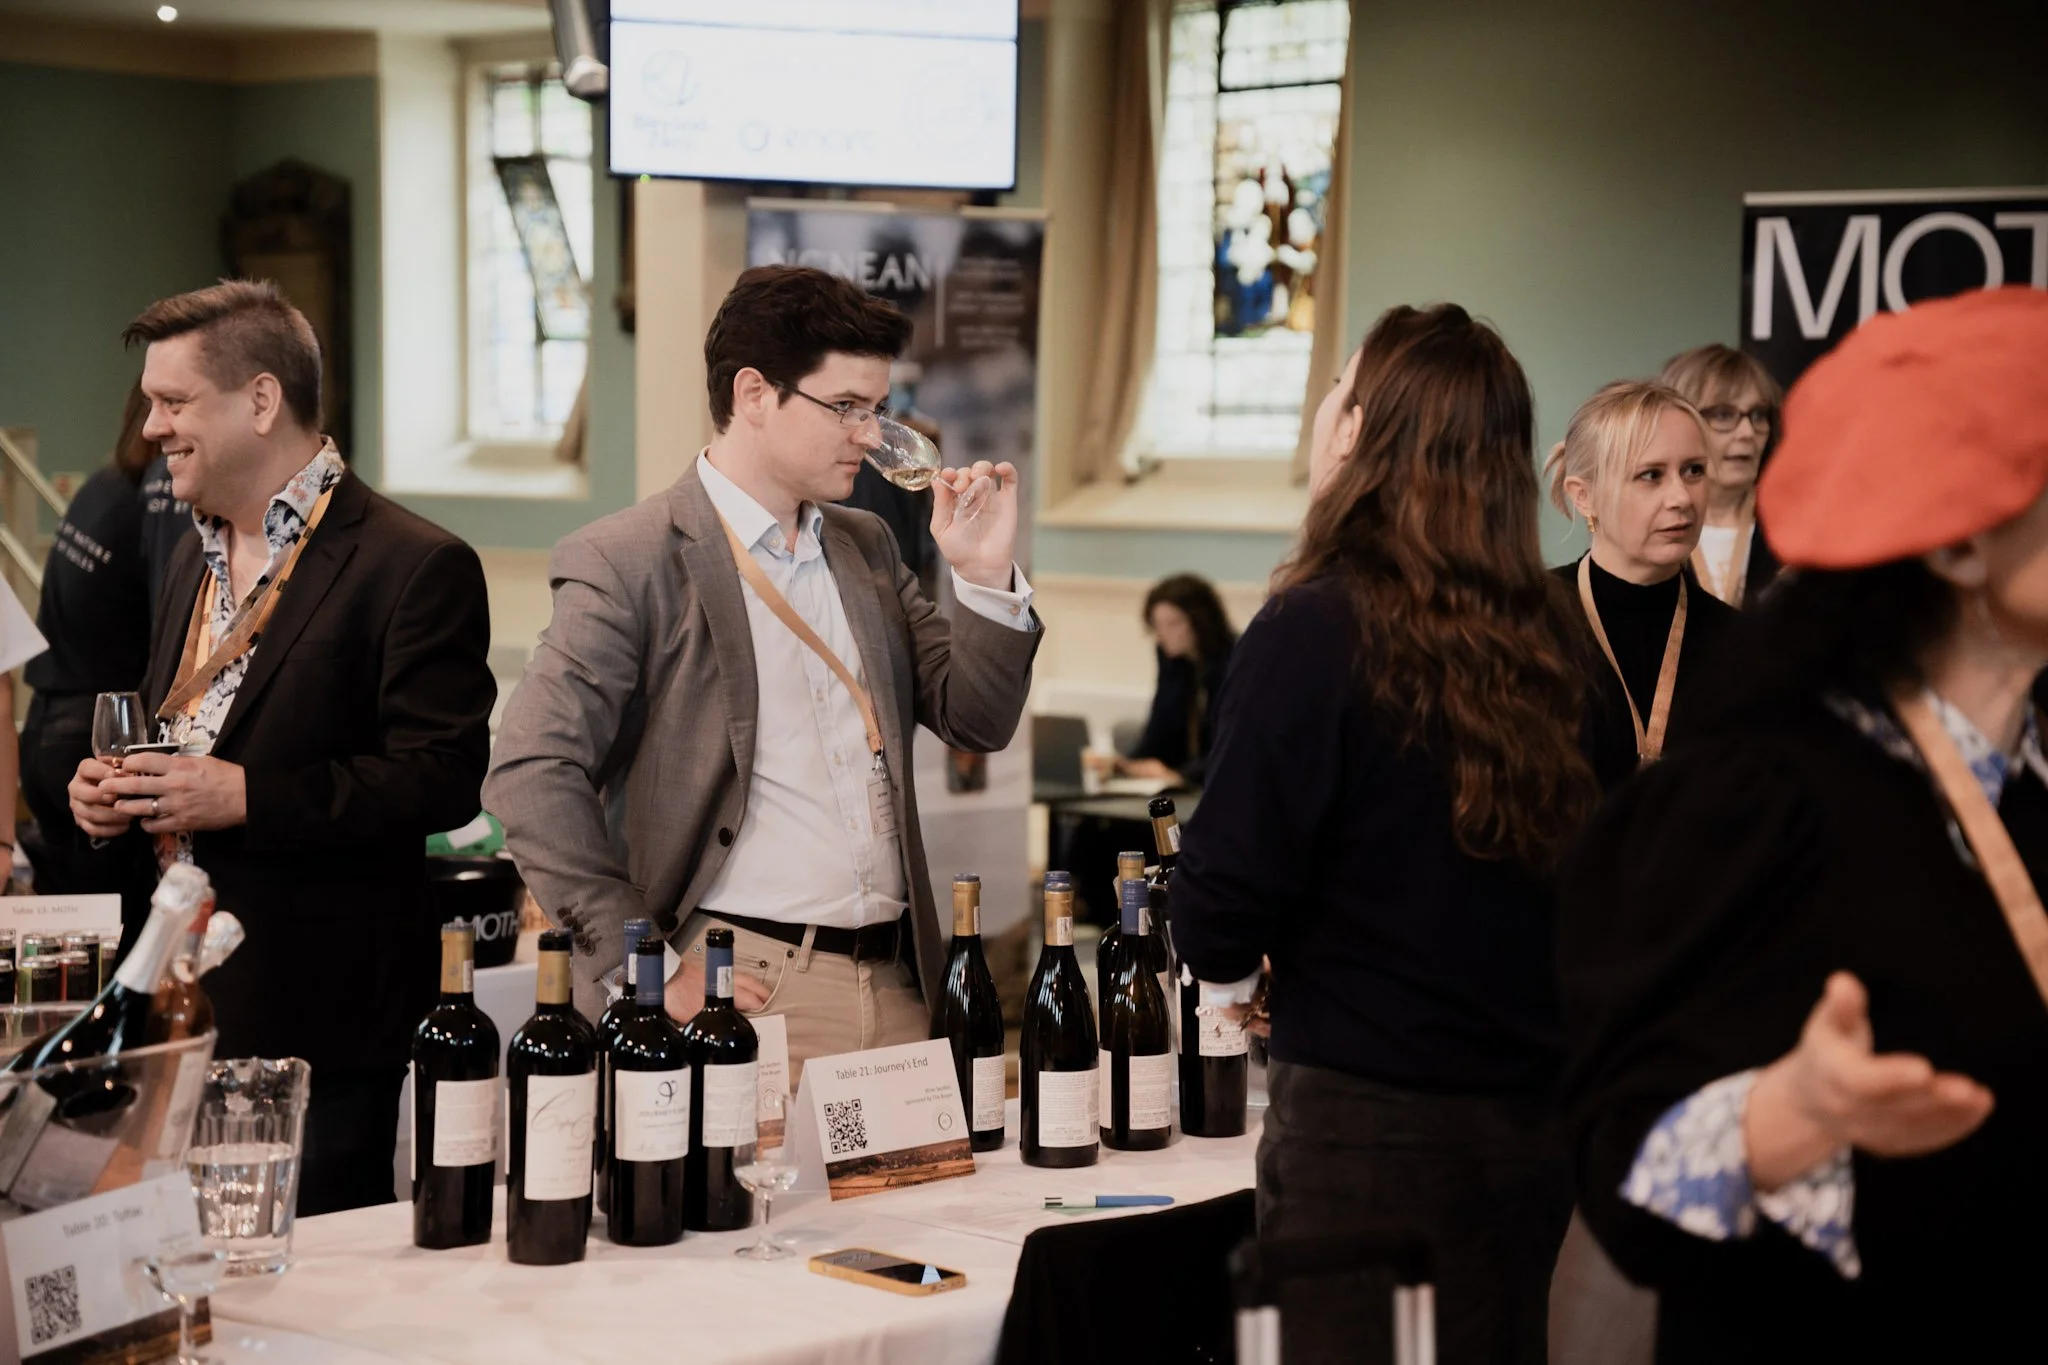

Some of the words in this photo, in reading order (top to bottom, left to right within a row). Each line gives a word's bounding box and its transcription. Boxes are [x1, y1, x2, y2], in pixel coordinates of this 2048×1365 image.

[835, 1068, 858, 1081] Table
[859, 1066, 873, 1078] 21:
[874, 1058, 912, 1075] Journey's
[912, 1056, 929, 1068] End
